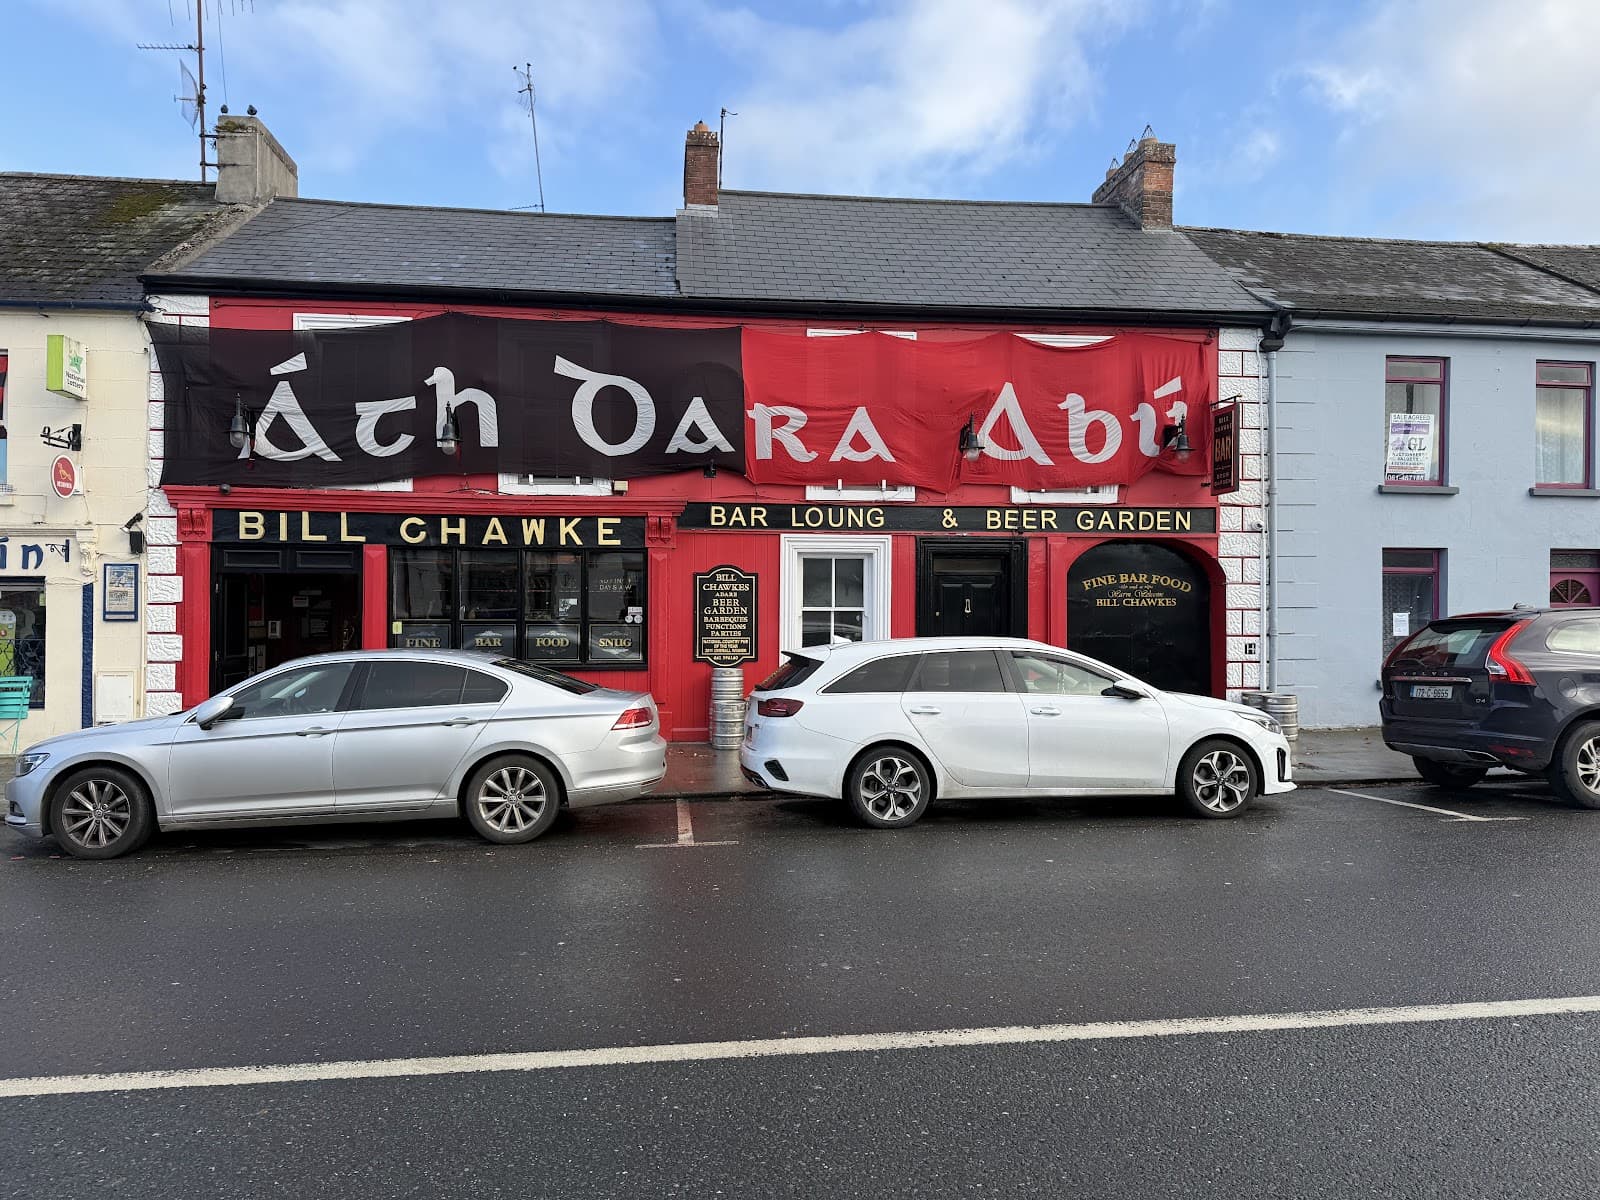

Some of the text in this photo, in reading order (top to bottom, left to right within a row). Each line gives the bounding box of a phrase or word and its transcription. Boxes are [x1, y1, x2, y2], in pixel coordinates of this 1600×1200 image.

[1215, 435, 1231, 463] BAR
[1407, 437, 1427, 451] GL
[710, 505, 1192, 531] BAR LOUNG & BEER GARDEN
[238, 511, 622, 546] BILL CHAWKE
[715, 573, 737, 582] BILL
[1082, 573, 1192, 593] FINE BAR FOOD
[702, 583, 750, 591] CHAWKES
[712, 598, 740, 607] BEER
[1096, 598, 1177, 607] BILL CHAWKES
[703, 606, 748, 615] GARDEN
[405, 637, 632, 648] FINE BAR FOOD SNUG
